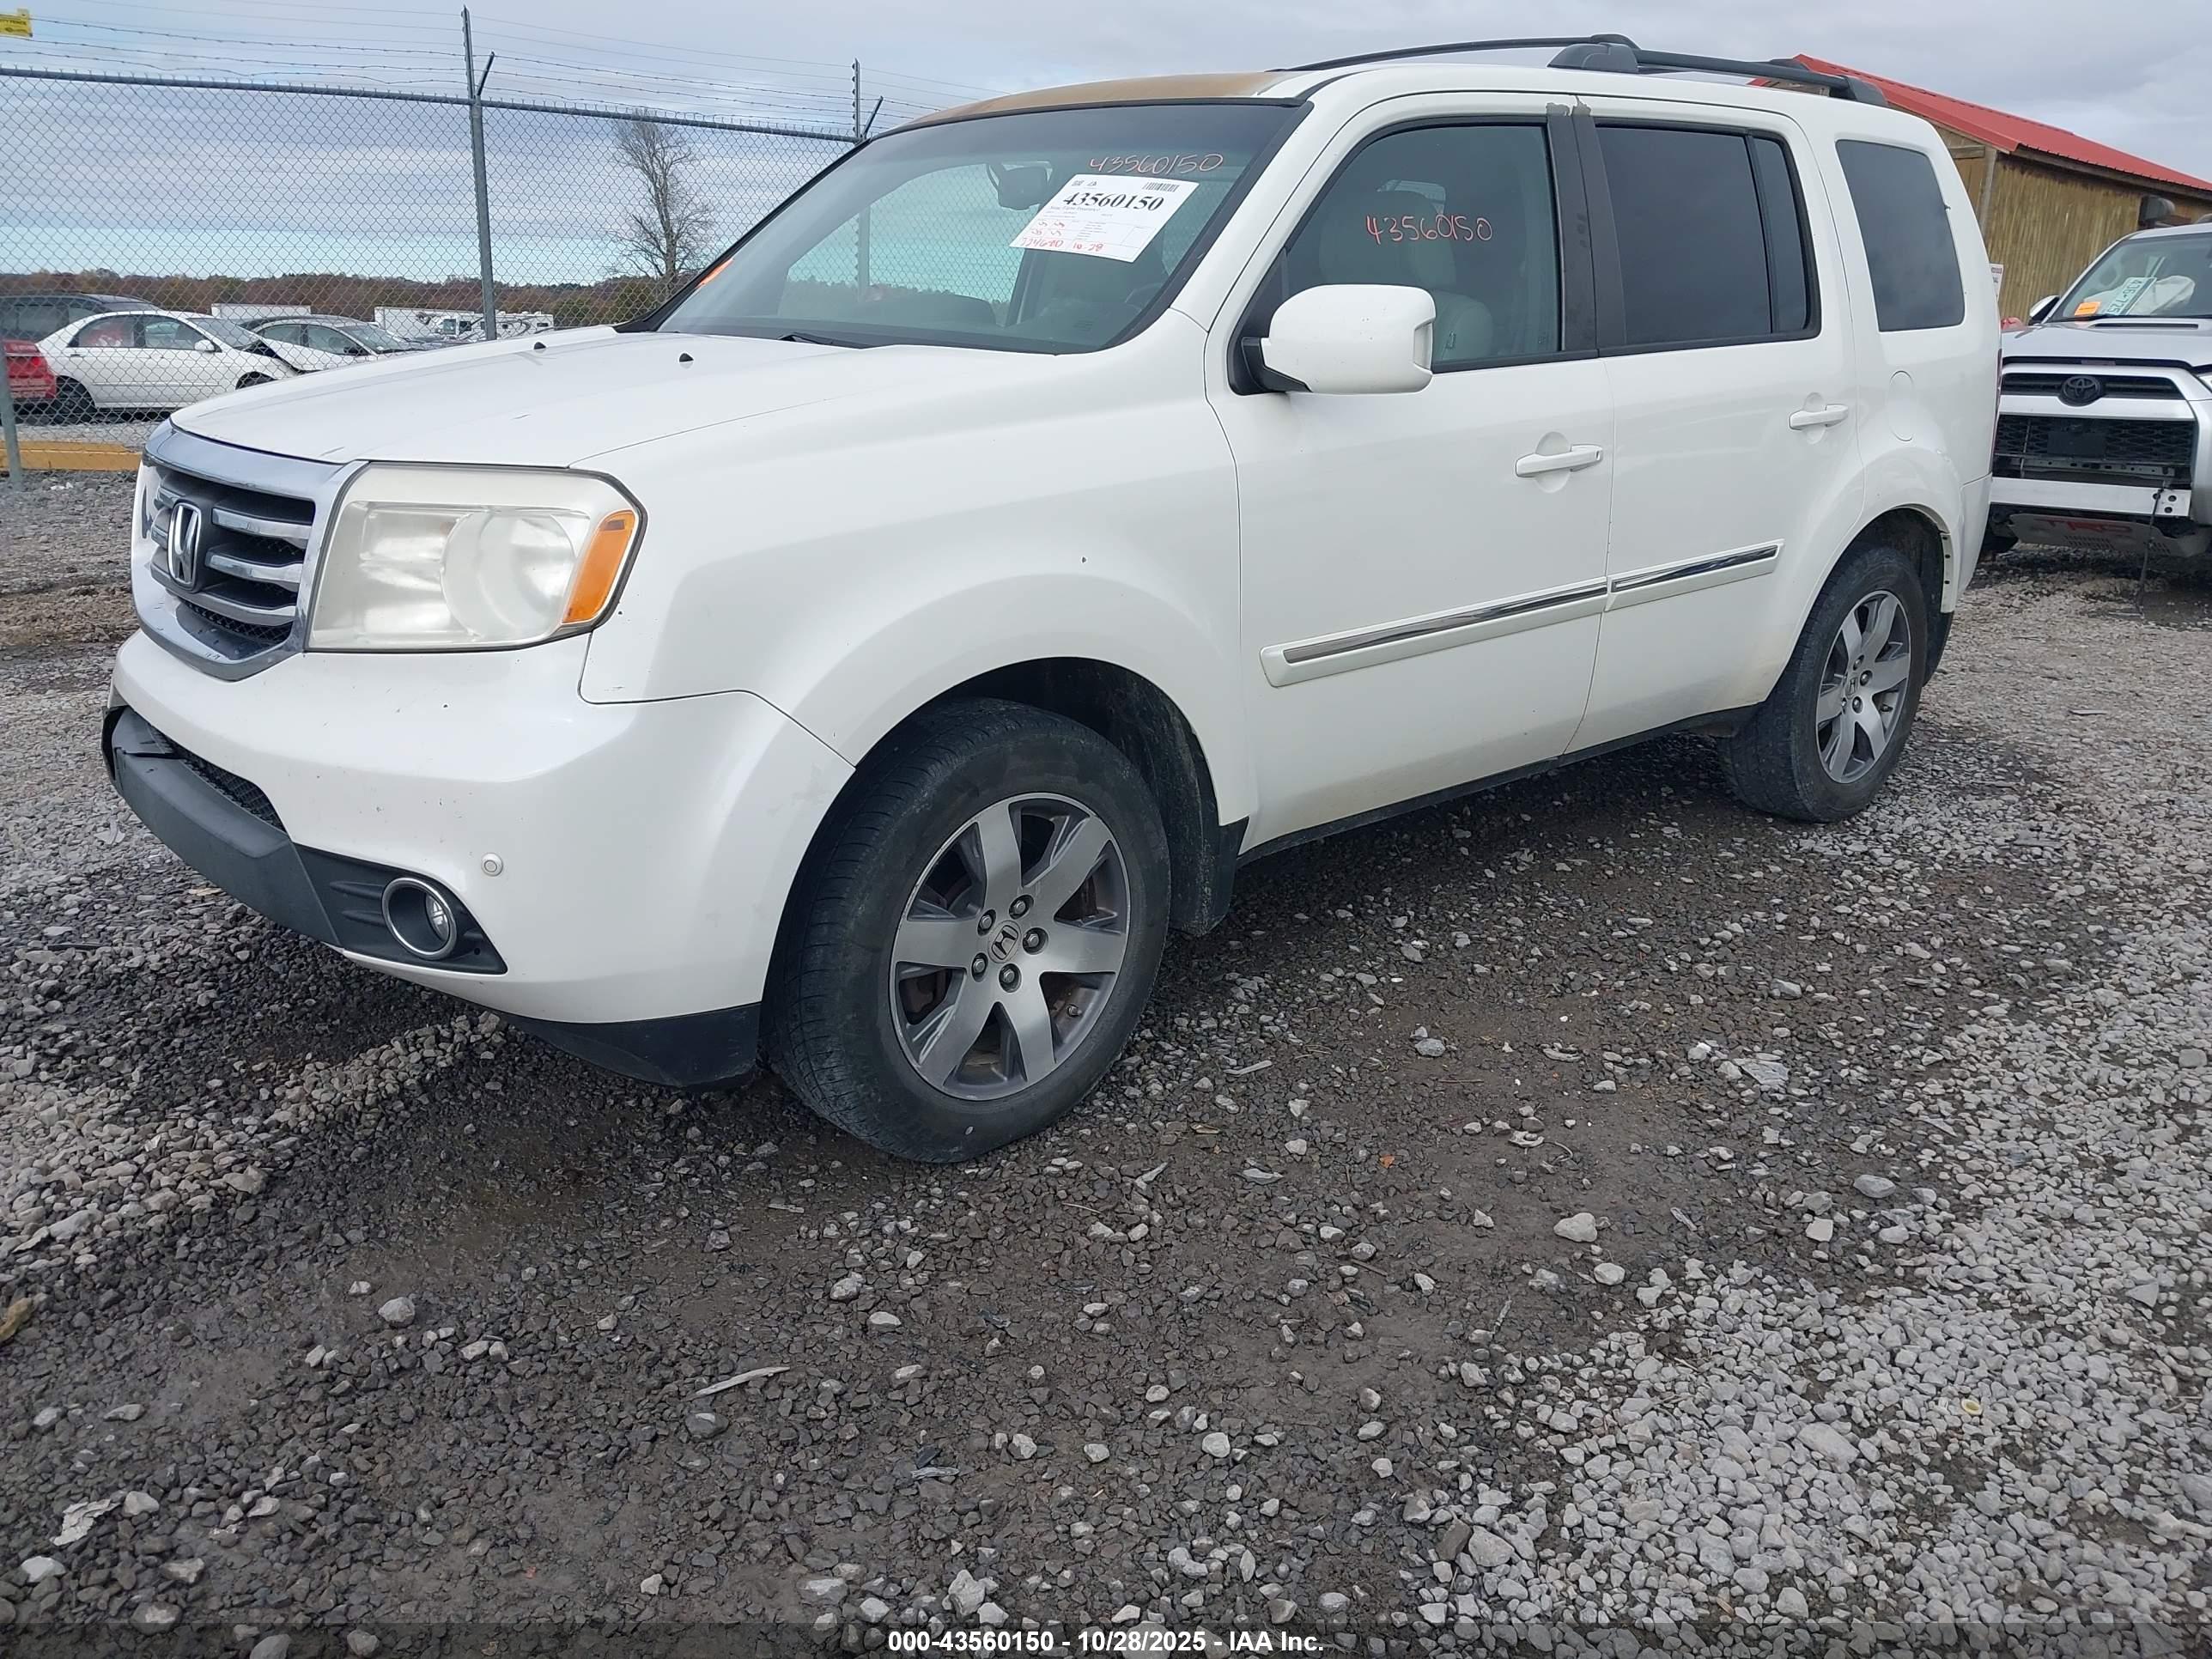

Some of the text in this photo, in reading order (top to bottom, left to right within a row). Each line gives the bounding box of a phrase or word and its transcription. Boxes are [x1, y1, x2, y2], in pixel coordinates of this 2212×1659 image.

[1090, 153, 1224, 174] 43560150
[1063, 191, 1164, 212] 43560150
[1366, 215, 1492, 245] 43560150
